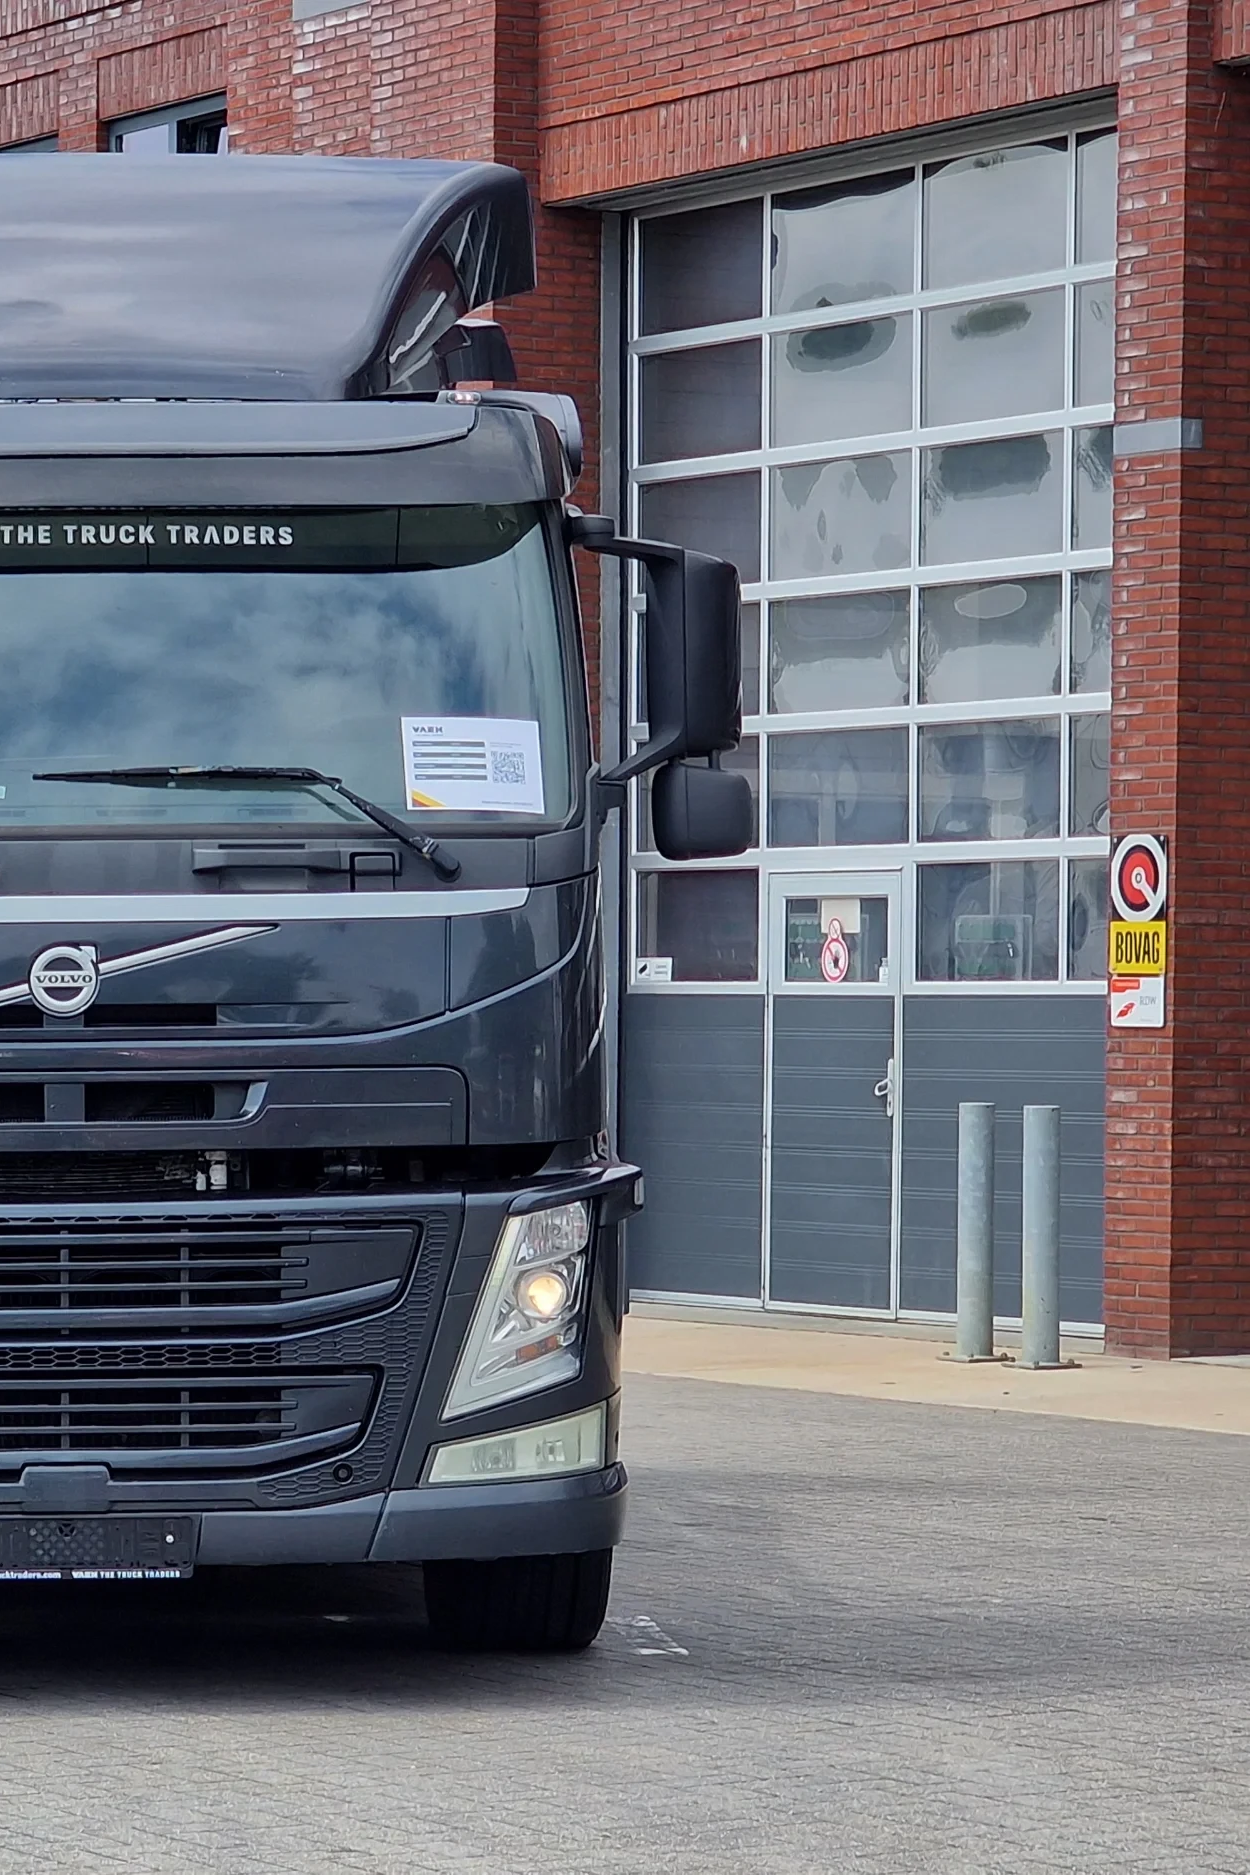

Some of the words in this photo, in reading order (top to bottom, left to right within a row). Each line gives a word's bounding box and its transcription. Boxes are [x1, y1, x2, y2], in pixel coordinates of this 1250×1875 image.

[0, 524, 51, 545] THE
[63, 523, 155, 545] TRUCK
[166, 523, 294, 546] TRADERS
[1115, 931, 1160, 965] BOVAG
[34, 974, 93, 984] VOLVO
[116, 1570, 143, 1579] TRUCK
